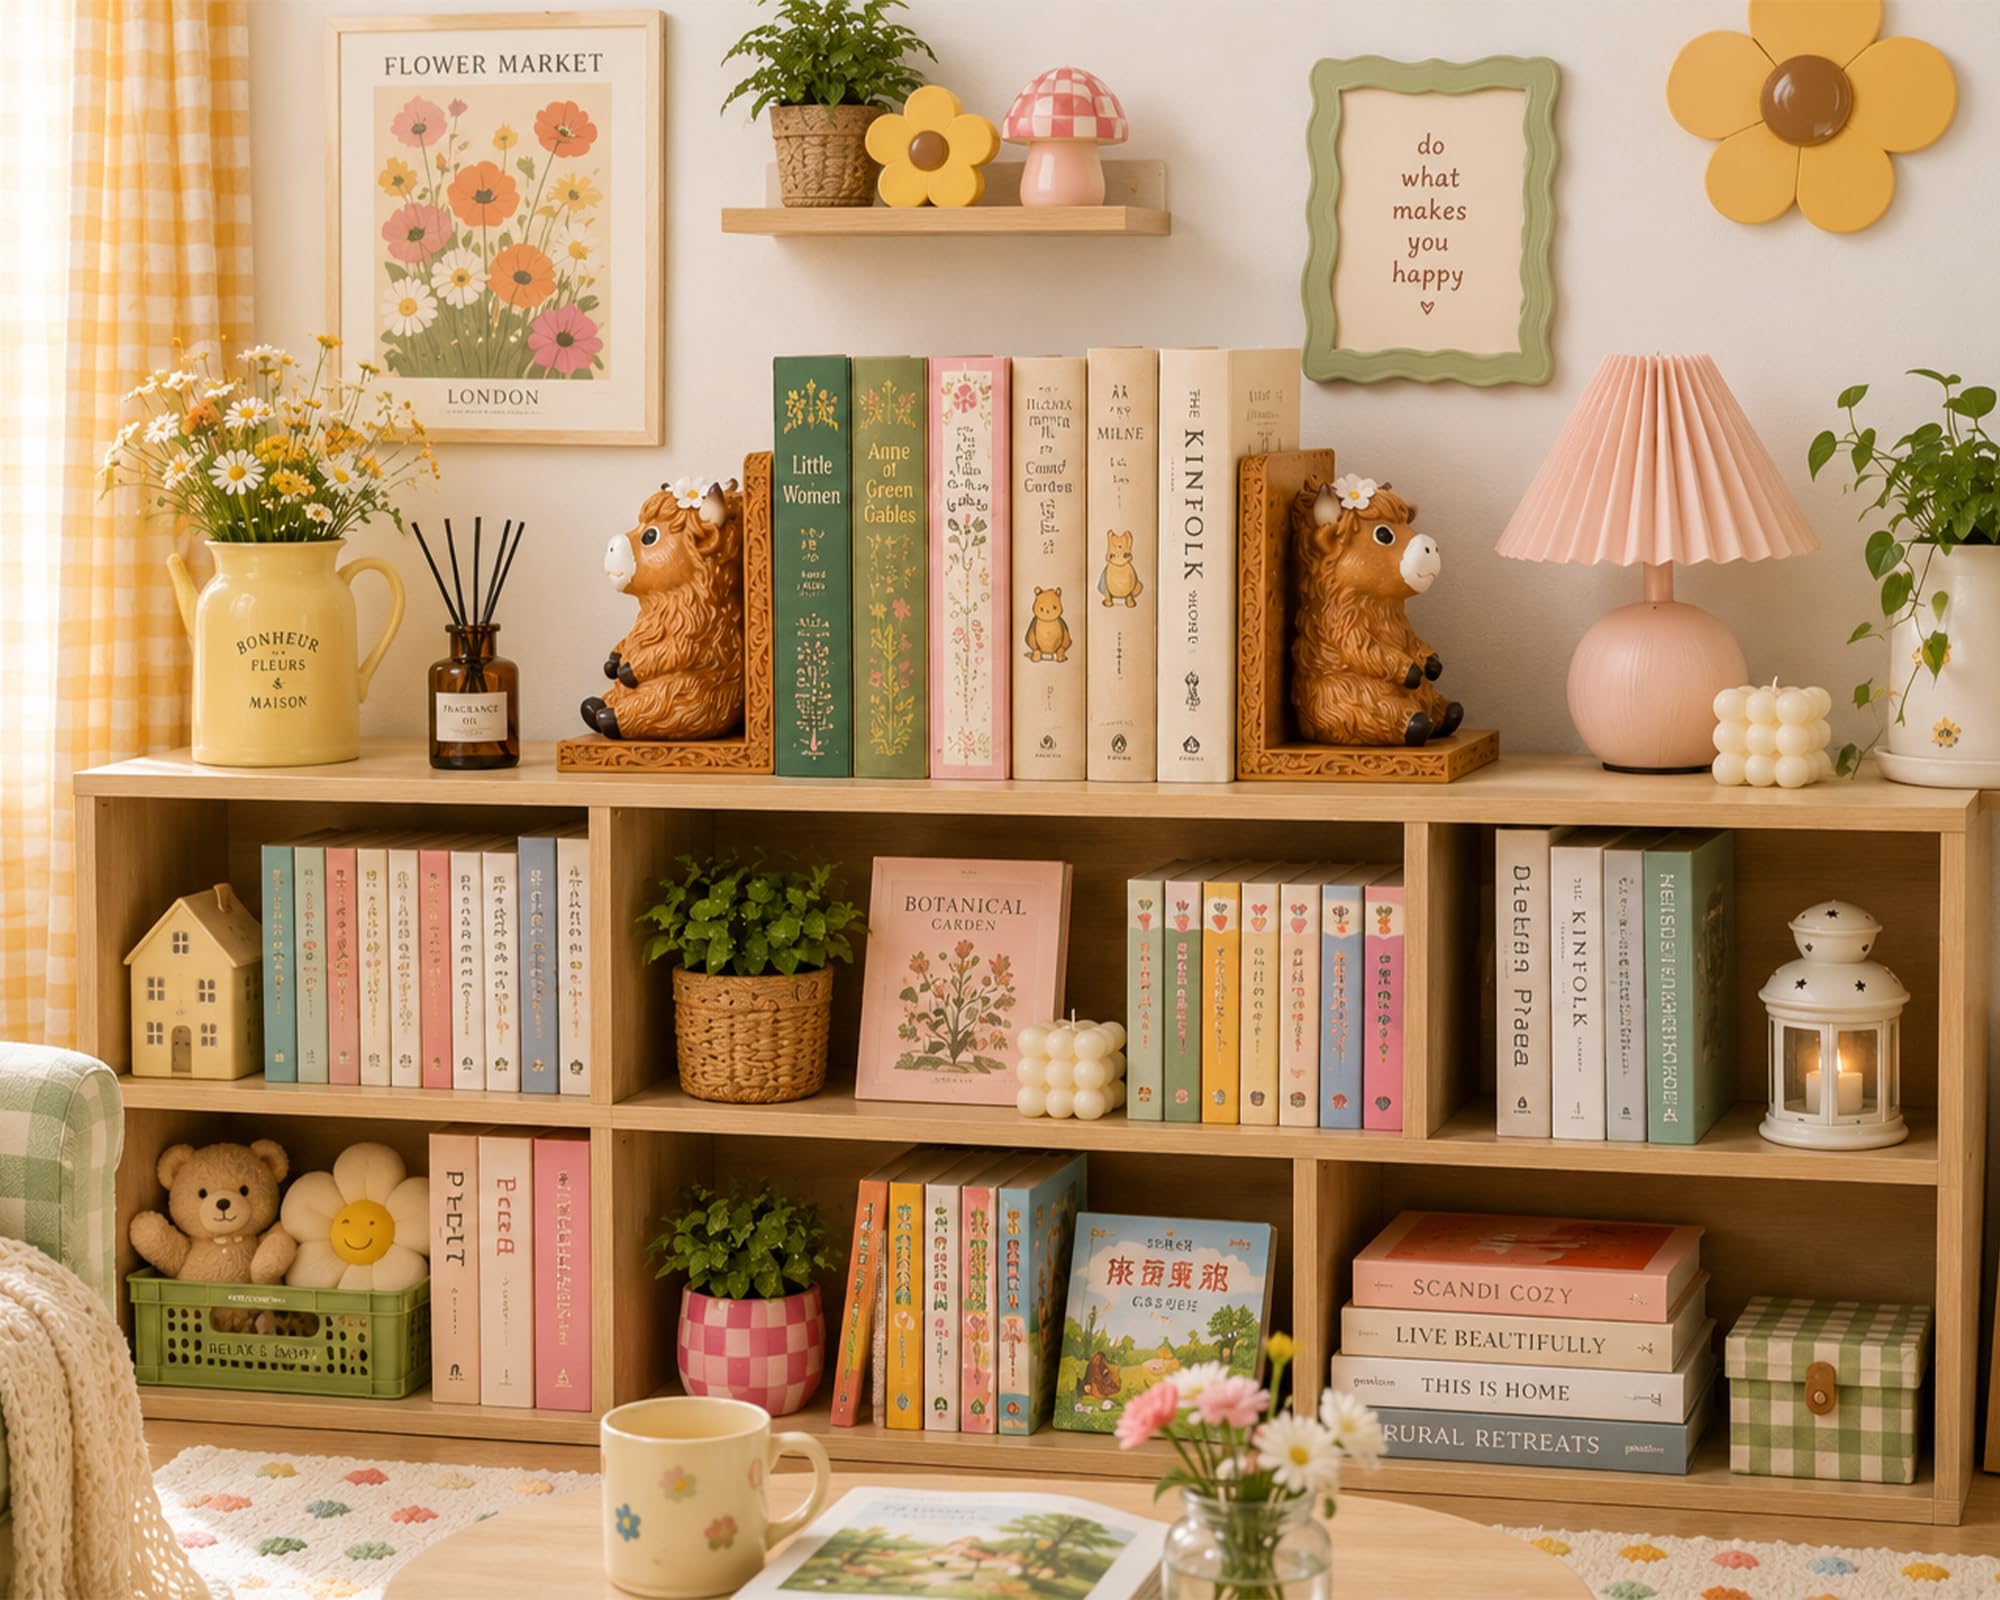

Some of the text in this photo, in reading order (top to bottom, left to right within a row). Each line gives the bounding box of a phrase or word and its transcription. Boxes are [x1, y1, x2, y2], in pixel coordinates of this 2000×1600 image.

[384, 52, 604, 76] FLOWER MARKET
[1417, 132, 1445, 155] do
[1401, 165, 1460, 188] what
[1392, 198, 1467, 221] makes
[1408, 236, 1448, 259] you
[1392, 260, 1464, 291] happy
[447, 388, 540, 406] LONDON
[1189, 389, 1201, 419] THE
[1097, 426, 1144, 440] MILNE
[868, 442, 911, 460] Anne
[792, 455, 833, 475] Little
[882, 461, 897, 477] of
[783, 485, 841, 505] Women
[865, 480, 913, 498] Green
[863, 504, 917, 524] Gables
[1184, 429, 1204, 580] KINFOLK
[236, 631, 319, 656] BONHEUR
[251, 658, 306, 671] FLEURS
[249, 695, 307, 709] MAISON
[904, 895, 1027, 916] BOTANICAL
[931, 917, 997, 932] GARDEN
[1572, 911, 1588, 1027] KINFOLK
[1412, 1278, 1573, 1305] SCANDI COZY
[1396, 1326, 1606, 1355] LIVE BEAUTIFULLY
[1421, 1377, 1570, 1402] THIS IS HOME
[1383, 1423, 1465, 1447] RURAL
[1475, 1428, 1600, 1455] RETREATS
